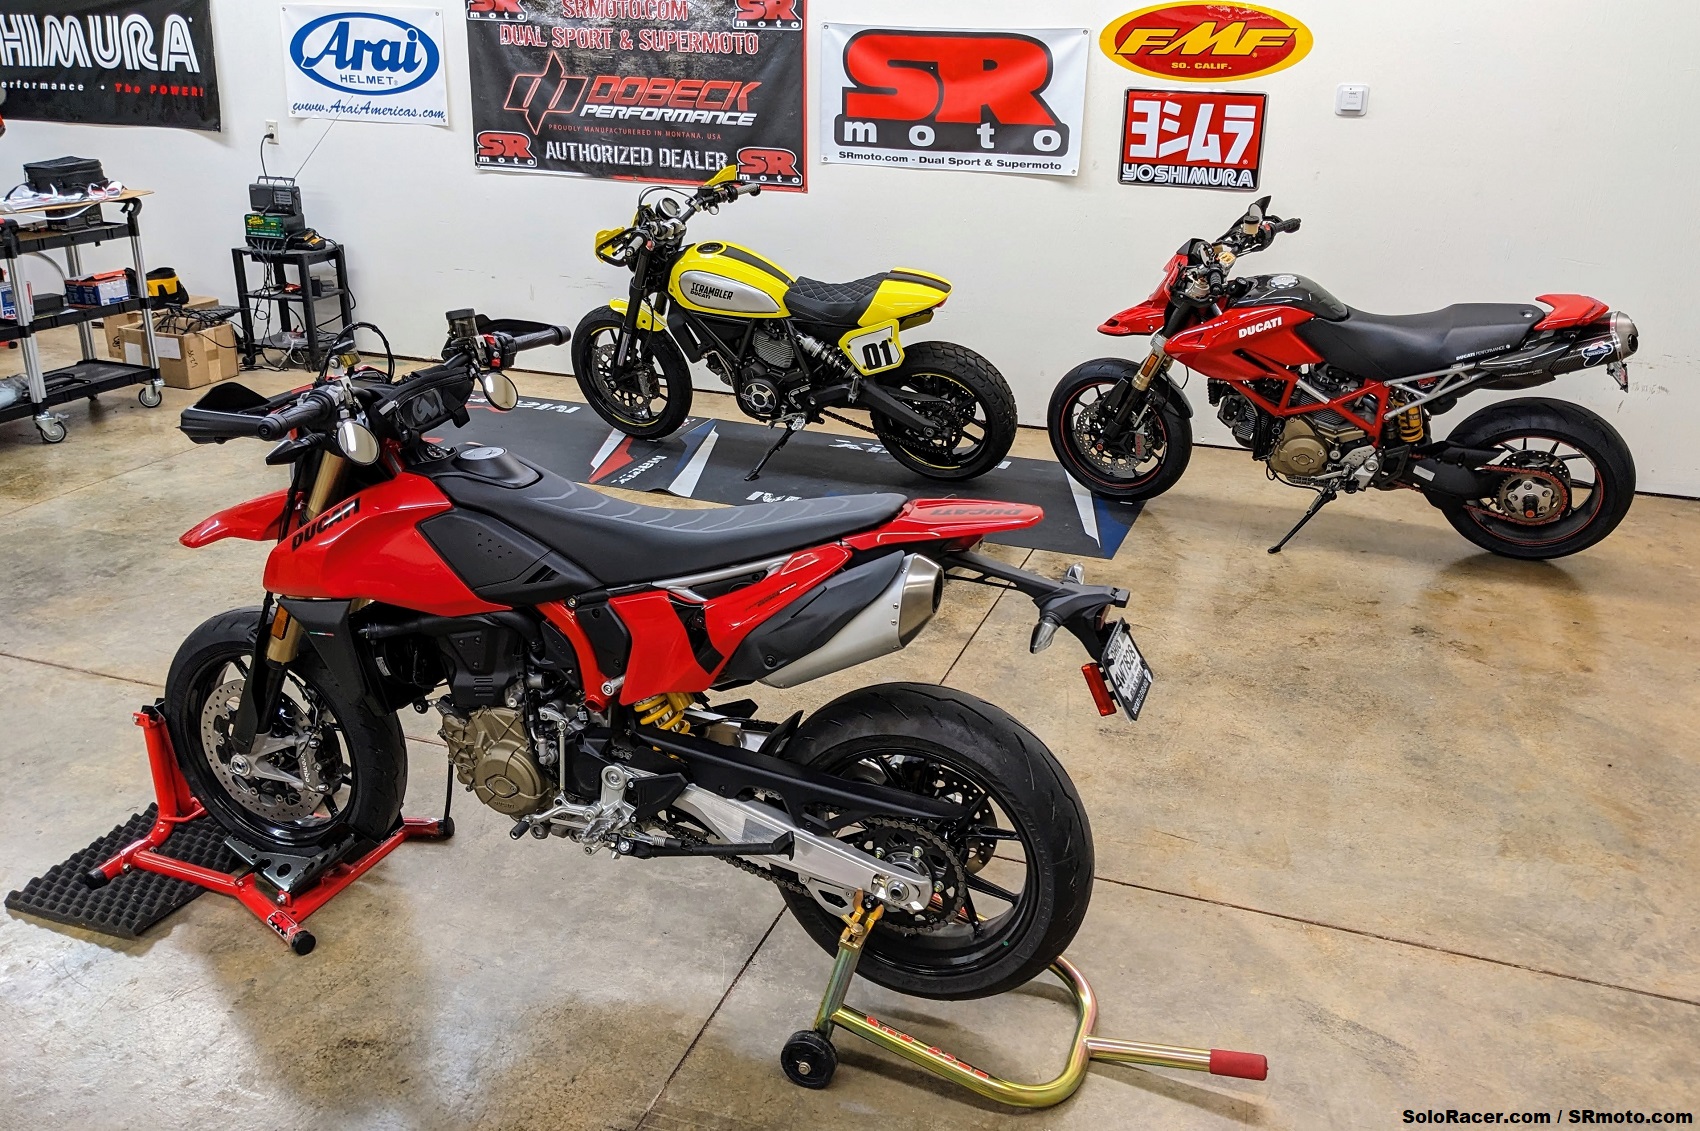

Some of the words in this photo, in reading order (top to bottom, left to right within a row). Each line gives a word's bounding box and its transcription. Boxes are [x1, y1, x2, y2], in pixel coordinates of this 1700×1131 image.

[470, 11, 525, 20] moto
[562, 0, 688, 20] SRMOTO.COM
[736, 19, 800, 28] moto
[302, 21, 422, 73] Arai
[500, 24, 547, 47] DUAL
[551, 26, 613, 50] SPORT
[619, 29, 633, 50] &
[639, 29, 759, 54] SUPERMOTO
[1114, 20, 1298, 56] FMF
[1194, 62, 1232, 70] CALIF.
[340, 74, 394, 86] HELMET
[846, 34, 1056, 126] SR
[586, 75, 763, 112] DOBECK
[292, 98, 446, 119] www.AraiAmericas.com
[579, 104, 757, 126] PERFORMANCE
[549, 124, 581, 132] PROUDLY
[665, 131, 704, 140] MONTANA,
[843, 121, 1062, 152] moto
[1130, 100, 1256, 164] ヨシムラ
[478, 132, 532, 158] SR
[545, 141, 654, 167] AUTHORIZED
[659, 147, 728, 171] DEALER
[479, 156, 535, 166] moto
[739, 149, 798, 175] SR
[838, 151, 908, 163] SRmoto.com
[919, 155, 945, 165] Dual
[948, 156, 981, 167] Sport
[984, 158, 993, 167] &
[996, 159, 1062, 171] Supermoto
[739, 173, 800, 183] moto
[1122, 163, 1254, 188] YOSHIMURA
[690, 290, 711, 299] DUCATI
[691, 282, 734, 300] SCRAMBLER
[1238, 316, 1283, 339] DUCATI
[862, 339, 894, 371] 01
[1455, 351, 1475, 361] DUCATI
[931, 508, 1024, 516] DUCATI
[291, 497, 360, 552] DUCATI
